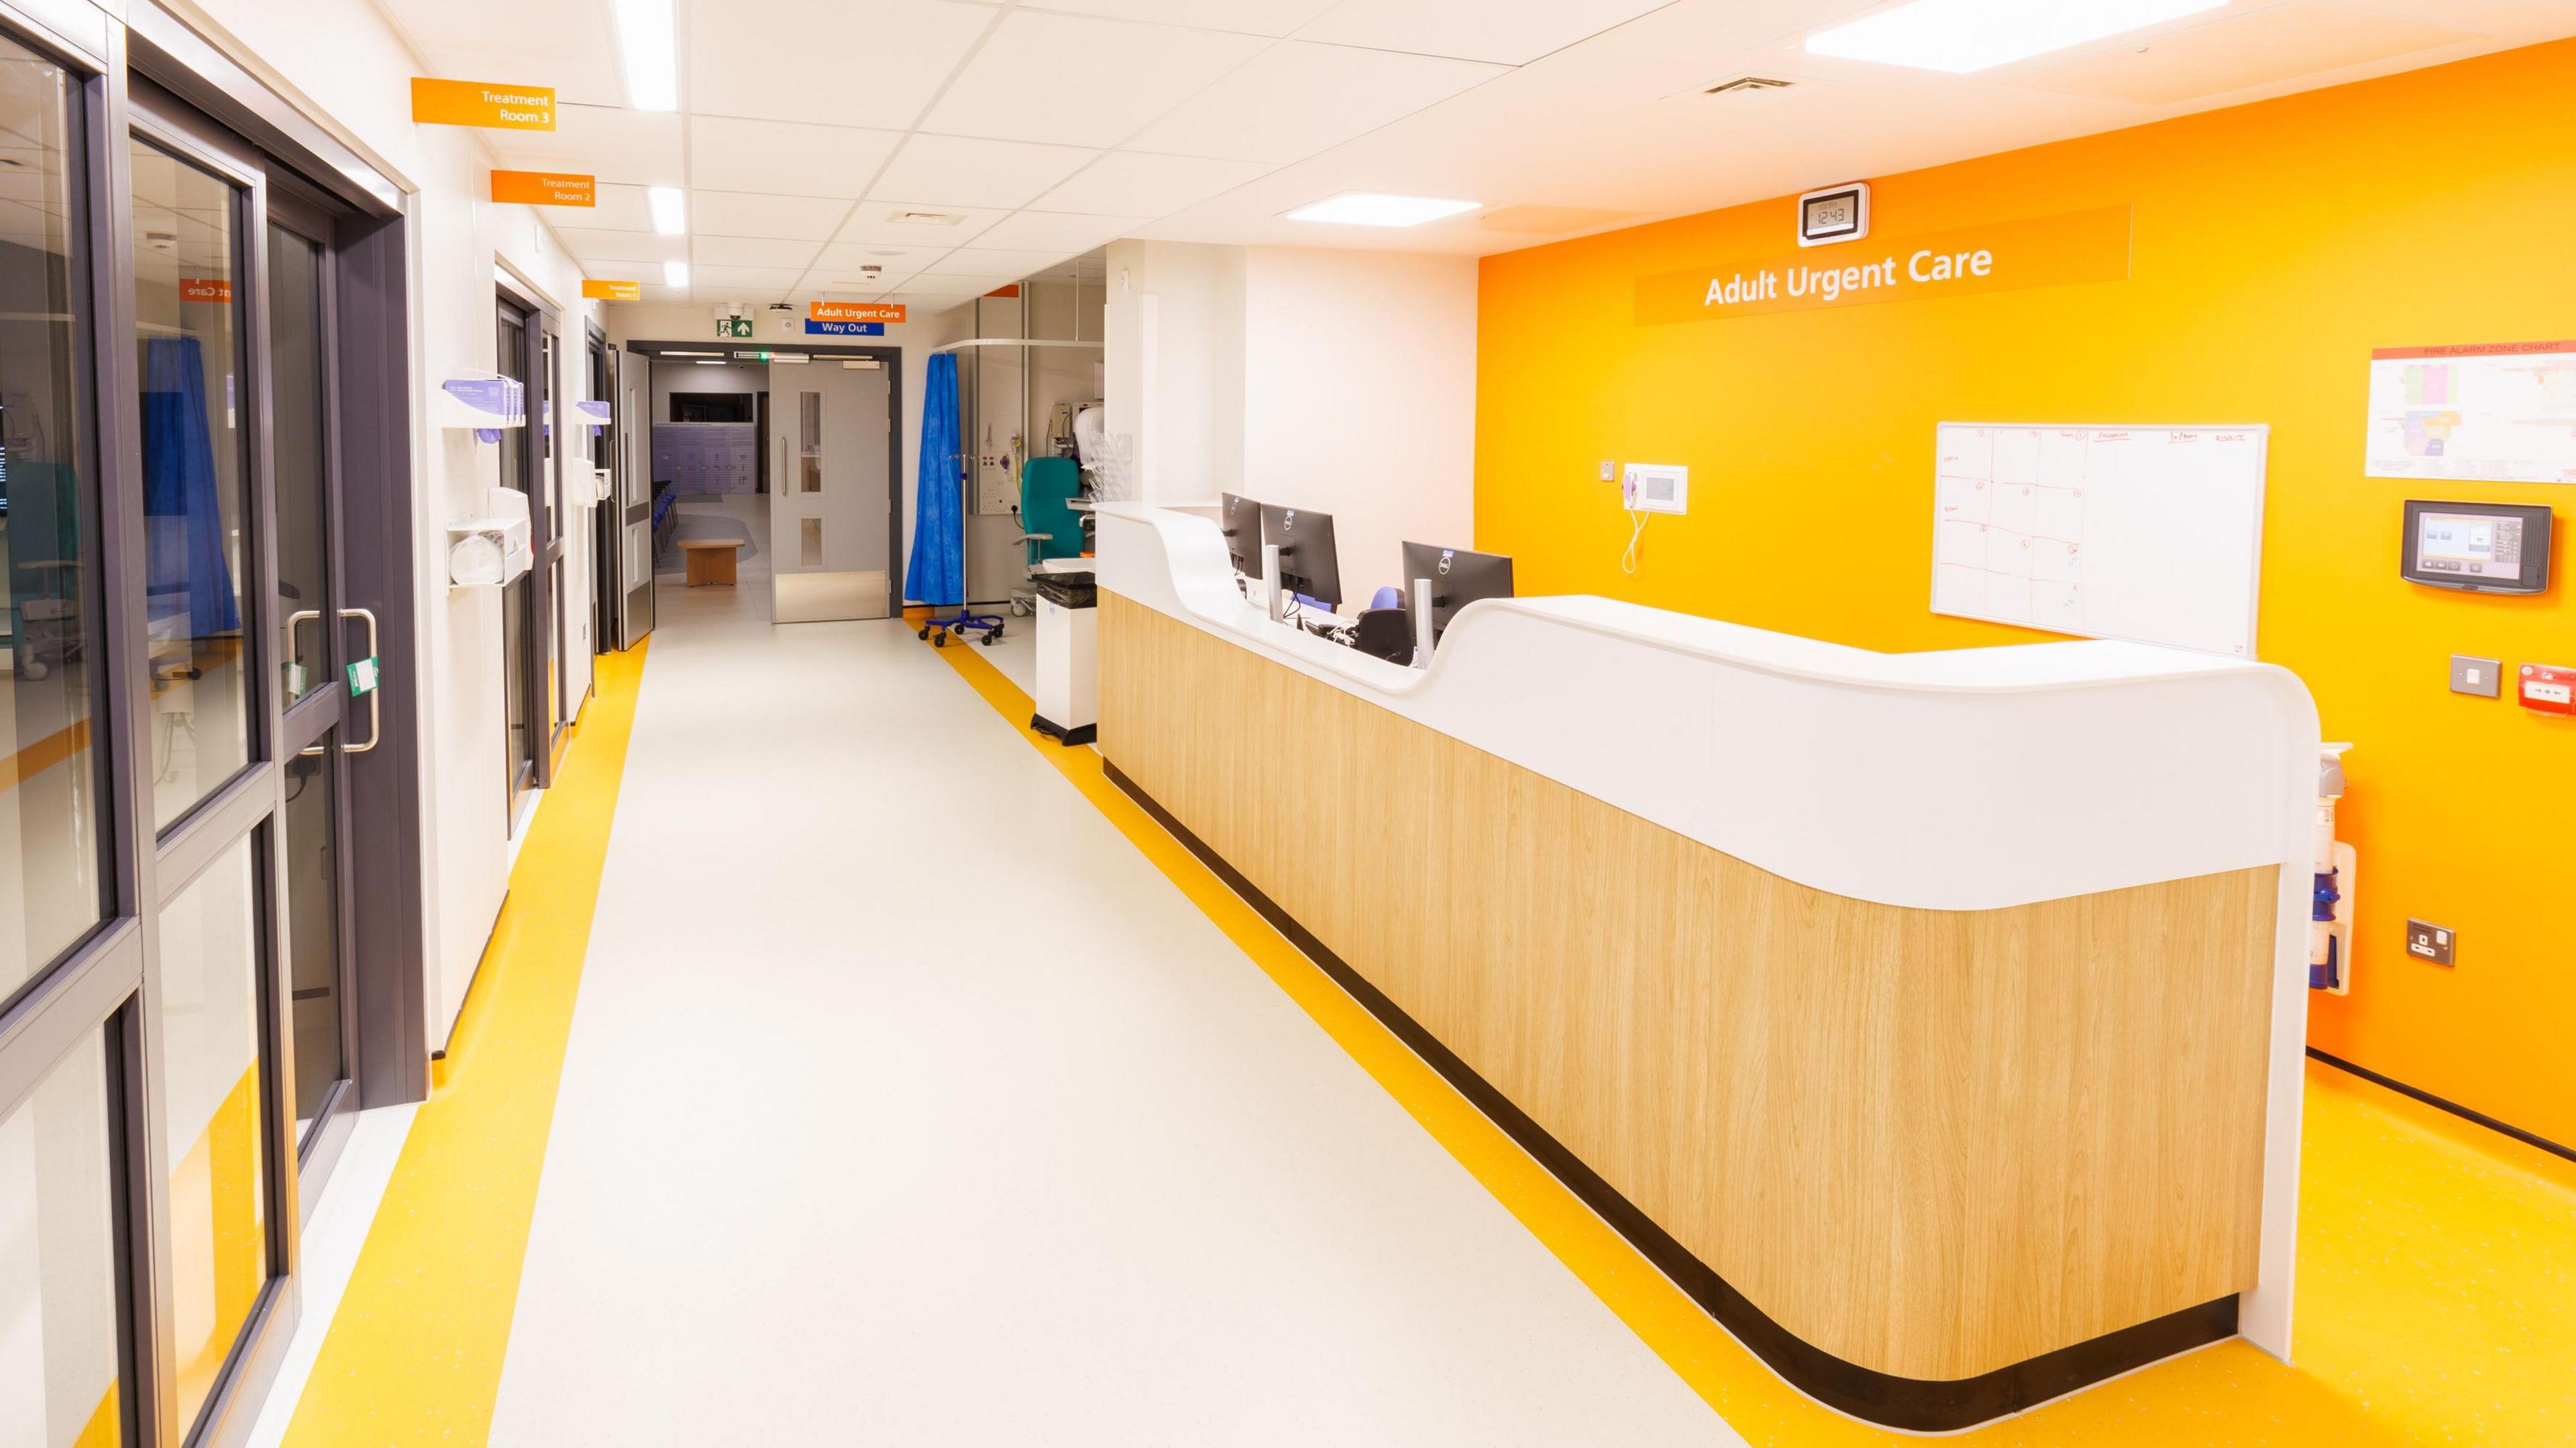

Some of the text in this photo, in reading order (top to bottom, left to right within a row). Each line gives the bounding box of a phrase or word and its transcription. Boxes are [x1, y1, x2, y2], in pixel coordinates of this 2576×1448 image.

[482, 91, 549, 107] Treatment
[500, 109, 549, 123] Room 3
[542, 178, 590, 189] Treatment
[554, 192, 590, 201] Room 2
[1705, 249, 1992, 305] Adult Urgent Care
[817, 308, 900, 319] Adult Urgent Care
[822, 323, 867, 333] Way Out
[2424, 343, 2561, 355] FIRE ALARM ZONE CHART
